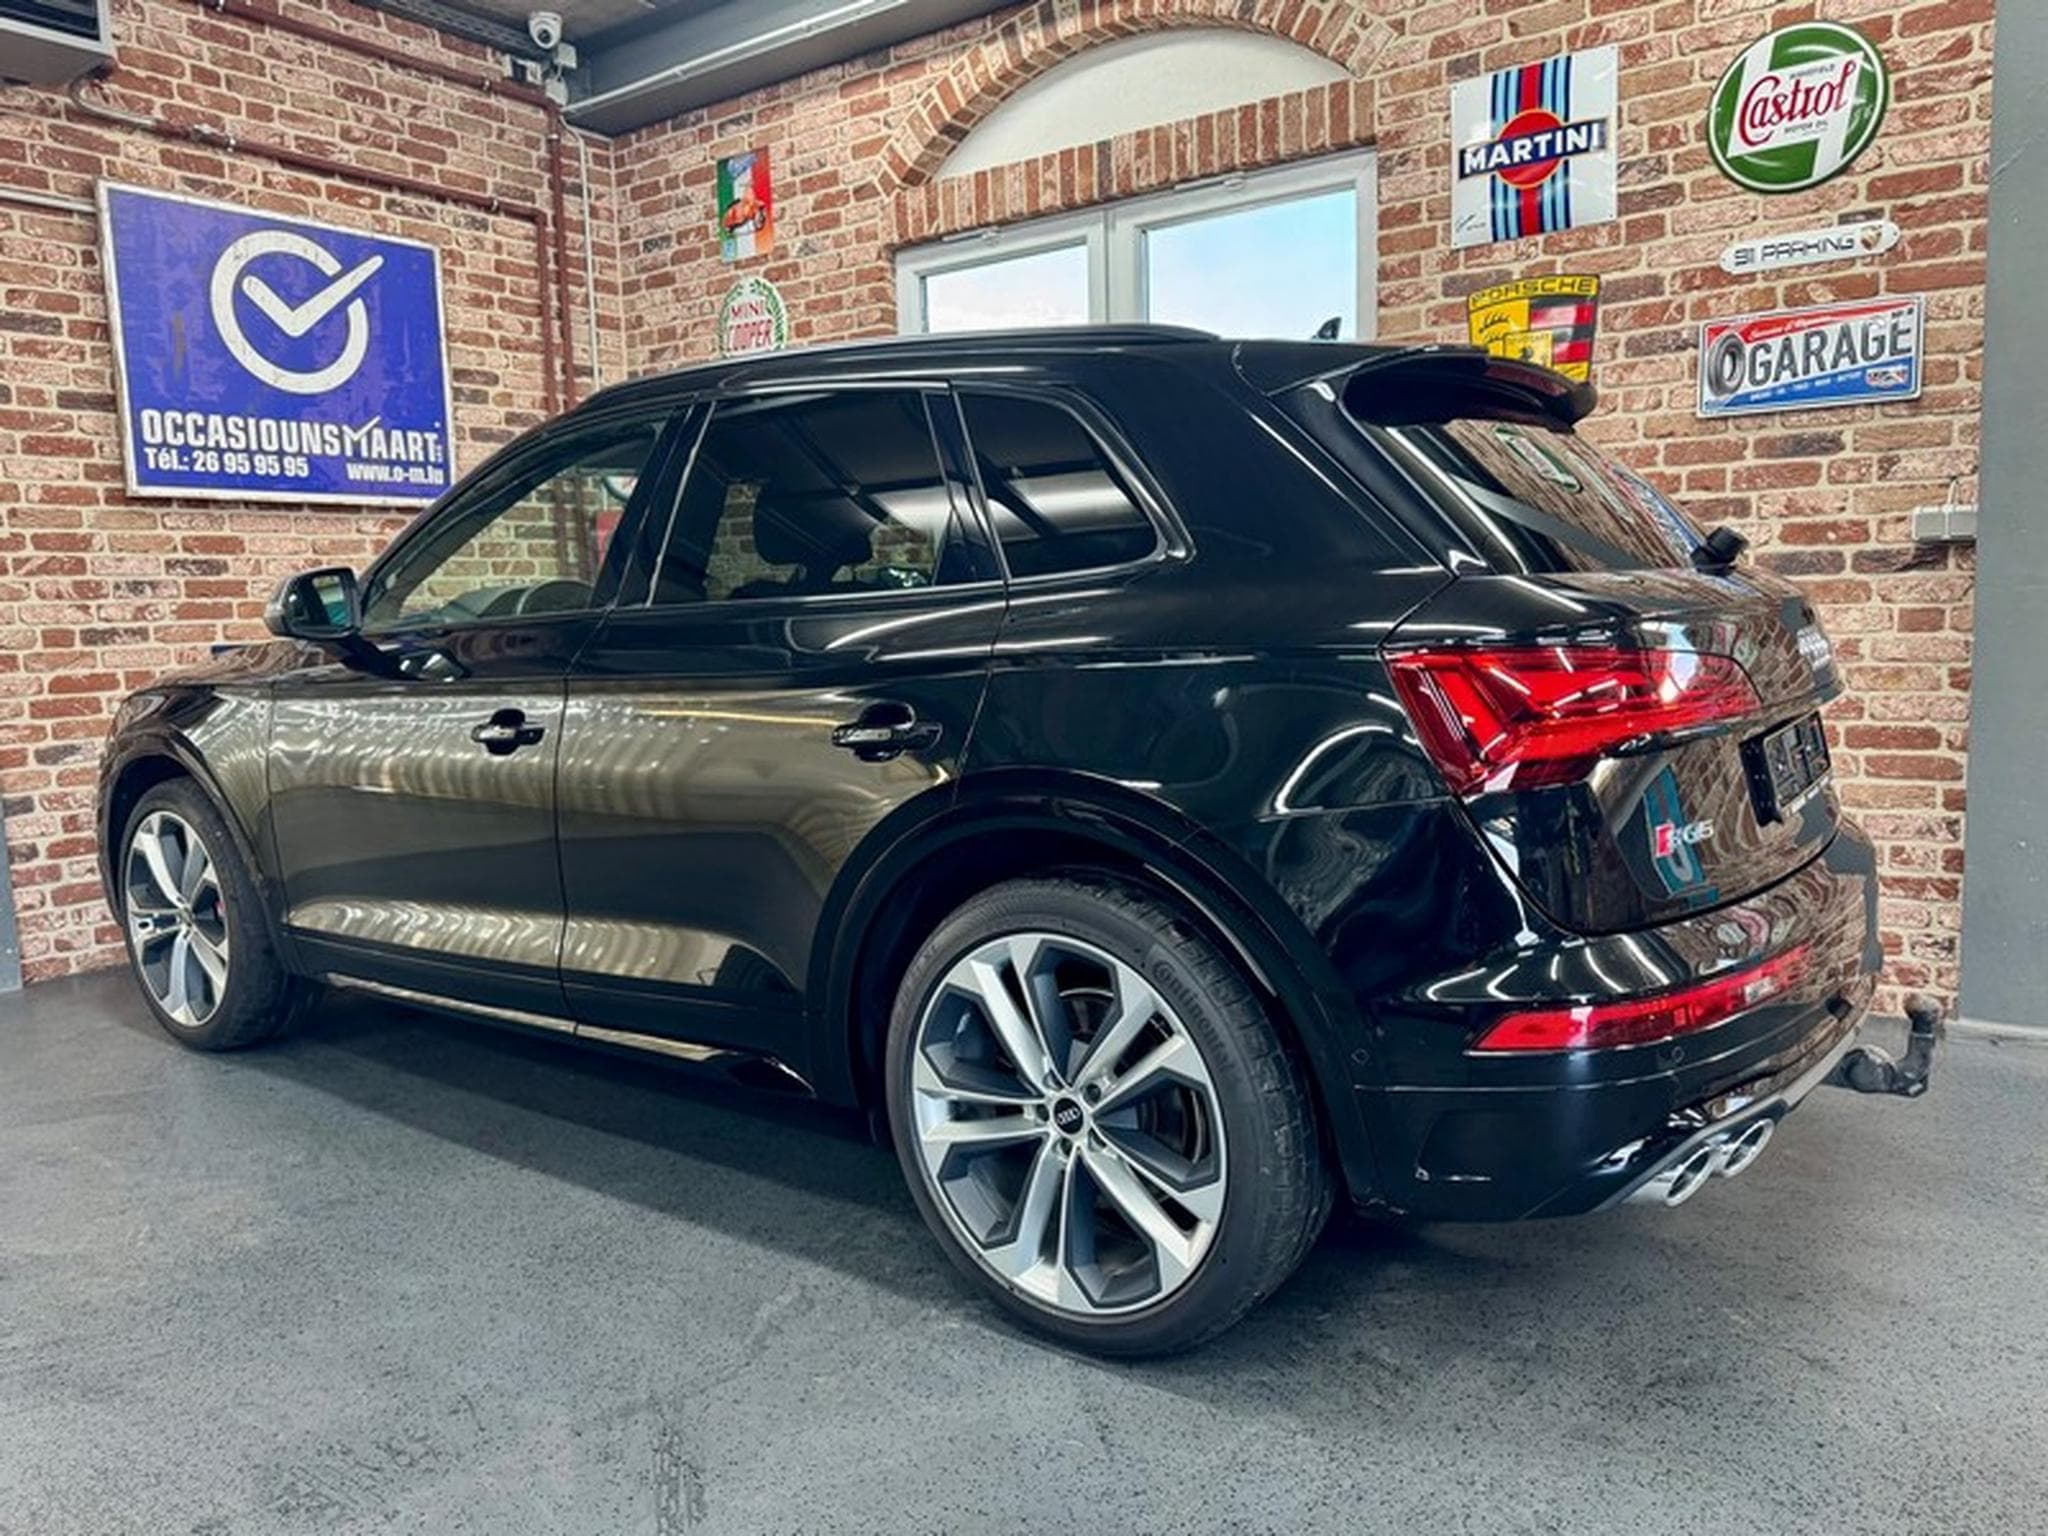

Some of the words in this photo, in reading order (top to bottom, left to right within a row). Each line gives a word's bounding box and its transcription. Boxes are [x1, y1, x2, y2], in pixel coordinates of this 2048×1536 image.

[1738, 59, 1858, 148] Castrol
[1463, 122, 1600, 175] MARTINI
[1761, 236, 1855, 262] PARKING
[1748, 307, 1914, 388] GARAGE
[140, 409, 440, 463] OCCASIOUNSMAART
[144, 447, 189, 471] Tél.:
[193, 450, 219, 472] 26
[220, 452, 250, 475] 95
[253, 454, 280, 476] 95
[283, 456, 309, 478] 95
